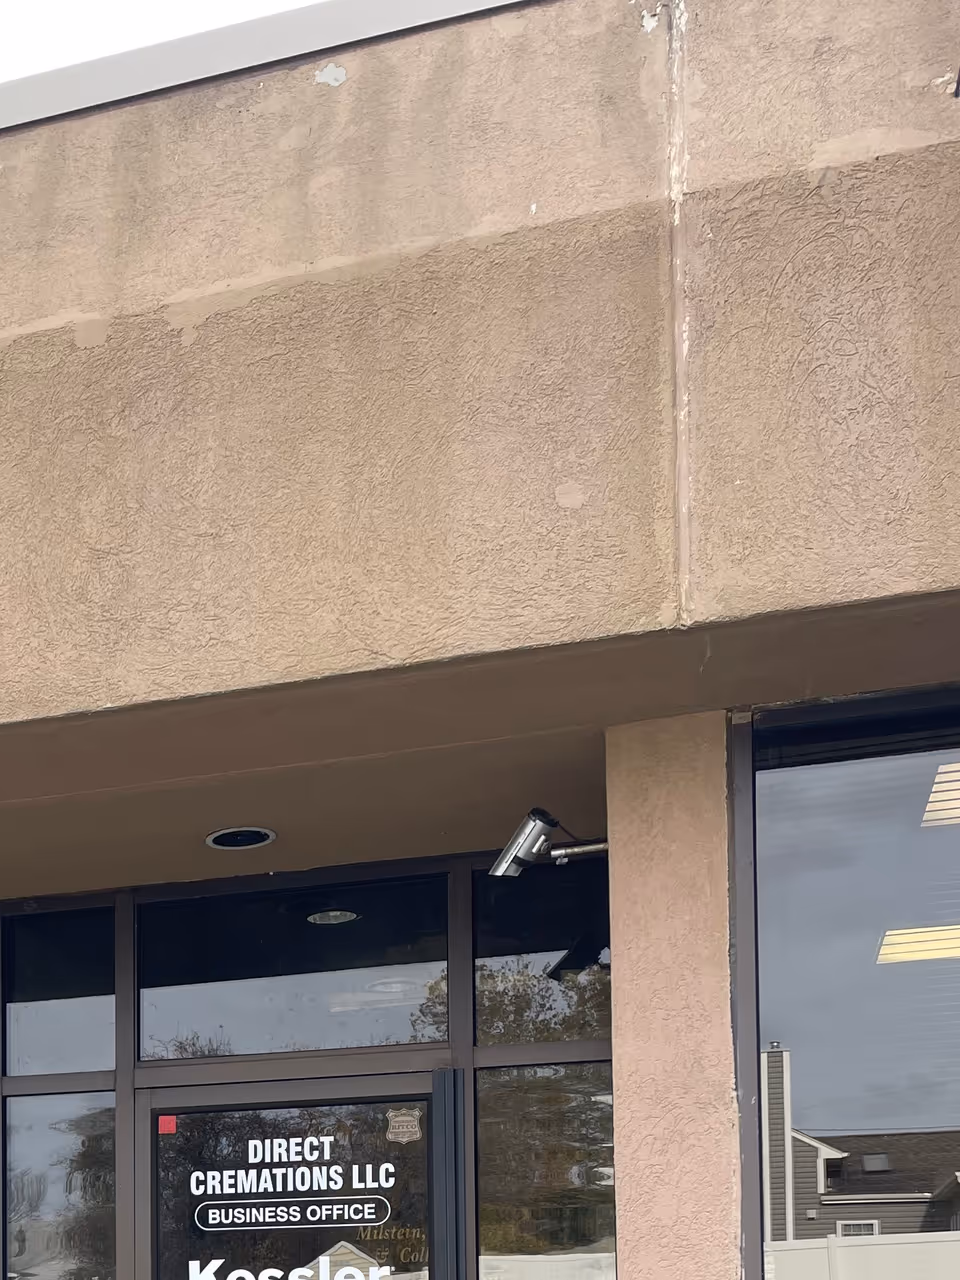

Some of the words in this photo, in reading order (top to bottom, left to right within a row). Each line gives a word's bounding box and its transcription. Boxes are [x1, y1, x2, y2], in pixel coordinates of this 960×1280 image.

[248, 1136, 334, 1164] DIRECT
[190, 1165, 344, 1195] CREMATIONS
[352, 1163, 395, 1189] LLC
[208, 1205, 301, 1224] BUSINESS
[306, 1203, 376, 1221] OFFICE
[356, 1224, 426, 1241] Milstein,
